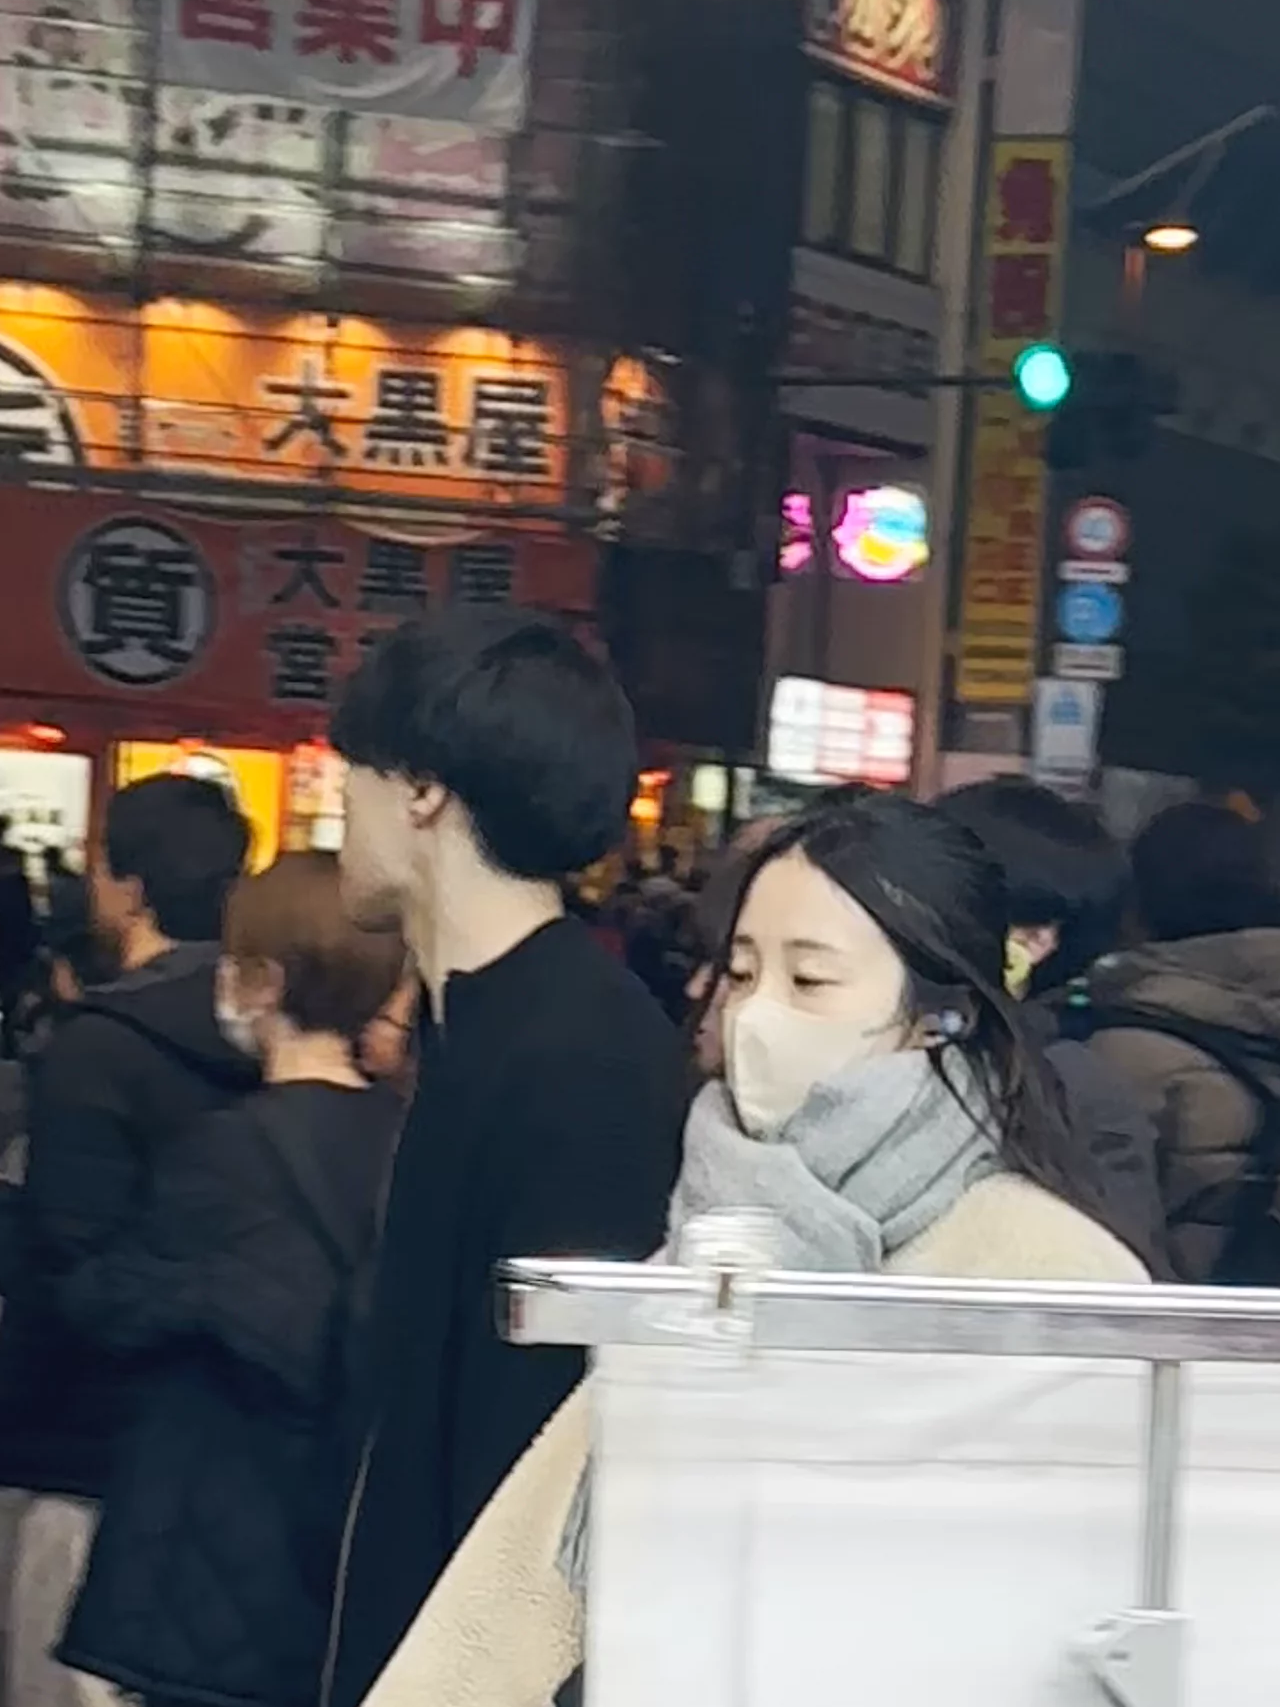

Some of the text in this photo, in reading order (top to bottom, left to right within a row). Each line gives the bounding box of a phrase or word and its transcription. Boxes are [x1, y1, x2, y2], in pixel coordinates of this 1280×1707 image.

[258, 359, 554, 480] 大黒屋
[80, 541, 201, 659] 質
